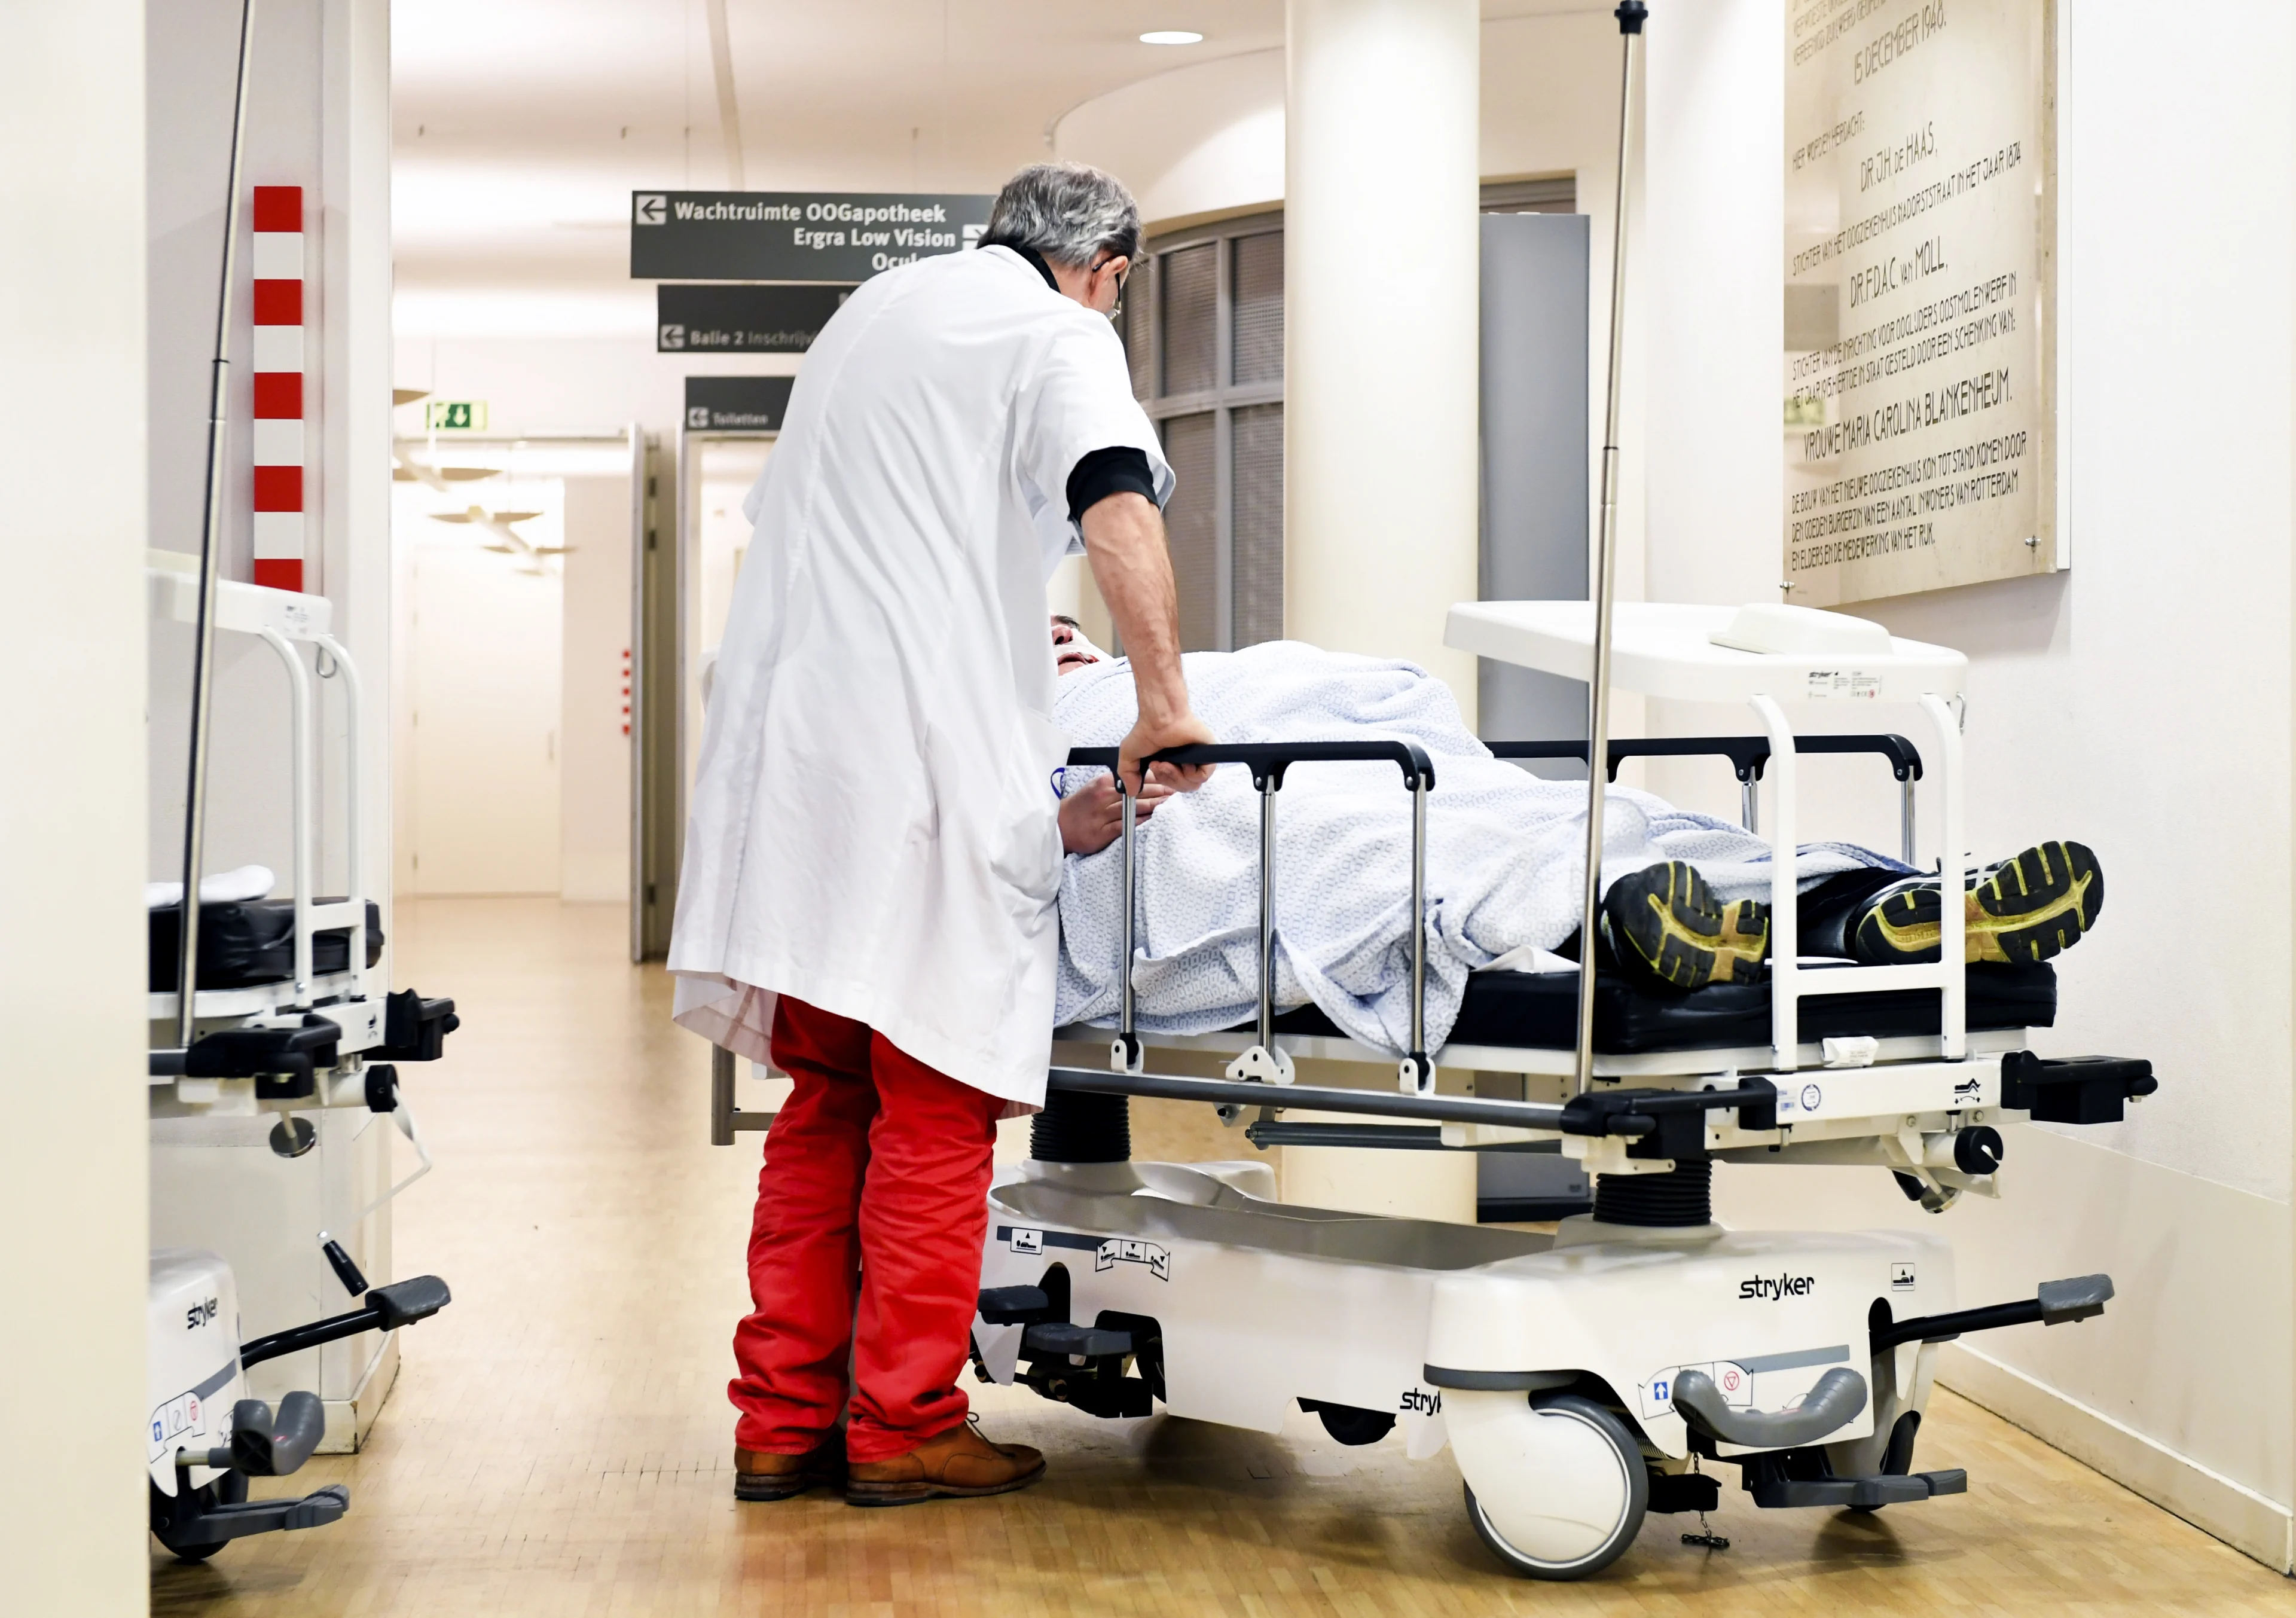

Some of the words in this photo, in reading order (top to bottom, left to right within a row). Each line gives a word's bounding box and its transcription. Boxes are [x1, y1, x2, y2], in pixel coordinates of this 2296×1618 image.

[1855, 51, 1863, 86] 15
[1866, 13, 1918, 78] DECEMBER
[1922, 0, 1946, 41] 1948.
[1793, 147, 1806, 173] HIER
[1895, 148, 1903, 173] DE
[1907, 121, 1937, 167] HAAS,
[674, 201, 801, 221] Wachtruimte
[806, 203, 947, 226] OOGapotheek
[1793, 245, 1821, 276] STICHTER
[1821, 239, 1833, 261] VAN
[1834, 231, 1846, 257] HET
[1847, 206, 1896, 249] OOGZIEKENHUIS
[1958, 170, 1964, 195] IN
[1966, 161, 1981, 191] HET
[1983, 149, 2004, 181] JAAR
[2006, 141, 2021, 170] 1874
[793, 227, 845, 250] Ergra
[851, 228, 890, 246] Low
[893, 228, 956, 247] Vision
[872, 252, 926, 270] Ocul
[1900, 260, 1913, 285] VAN
[1915, 236, 1948, 280] MOLL,
[690, 329, 730, 346] Balie
[733, 330, 744, 346] 2
[1793, 351, 1820, 380] STICHTER
[1821, 347, 1833, 370] VAN
[1834, 343, 1842, 365] DE
[1843, 328, 1876, 362] INRICHTING
[1878, 321, 1895, 346] VOOR
[1940, 275, 2007, 323] OOSTMOLENWERF
[2009, 271, 2016, 297] IN
[1793, 387, 1804, 408] HET
[1805, 381, 1820, 405] JAAR
[1859, 365, 1865, 386] IN
[1866, 357, 1883, 383] STAAT
[1885, 346, 1915, 376] GESTELD
[1918, 337, 1935, 365] DOOR
[1938, 330, 1952, 358] EEN
[1955, 313, 1996, 351] SCHENKING
[1999, 307, 2015, 334] VAN:
[1804, 423, 1840, 462] VROUWE
[1843, 414, 1871, 451] MARIA
[1874, 396, 1922, 441] CAROLINA
[1793, 494, 1799, 514] DE
[1801, 489, 1817, 512] BOUW
[1819, 486, 1830, 507] VAN
[1831, 482, 1843, 505] HET
[1844, 475, 1868, 502] NIEUWE
[1869, 460, 1921, 494] OOGZIEKENHUIS
[1923, 456, 1936, 482] KON
[1938, 452, 1951, 477] TOT
[1953, 445, 1975, 473] STAND
[1977, 437, 2003, 468] KOMEN
[2005, 431, 2026, 460] DOOR
[1792, 521, 1803, 543] DEN
[1805, 515, 1828, 540] GOEDEN
[1829, 507, 1863, 535] BURGERZIN
[1864, 504, 1875, 526] VAN
[1877, 500, 1890, 524] EEN
[1891, 494, 1917, 521] AANTAL
[1918, 484, 1954, 514] INWONERS
[1956, 480, 1969, 505] VAN
[1971, 468, 2018, 502] ROTTERDAM
[1792, 550, 1799, 571] EN
[1801, 545, 1824, 569] ELDERS
[1824, 542, 1833, 565] EN
[1834, 542, 1842, 563] DE
[1843, 531, 1889, 562] MEDEWERKING
[1891, 529, 1903, 552] VAN
[1904, 526, 1917, 550] HET
[1739, 1272, 1815, 1301] stryker
[188, 1296, 218, 1330] stryker
